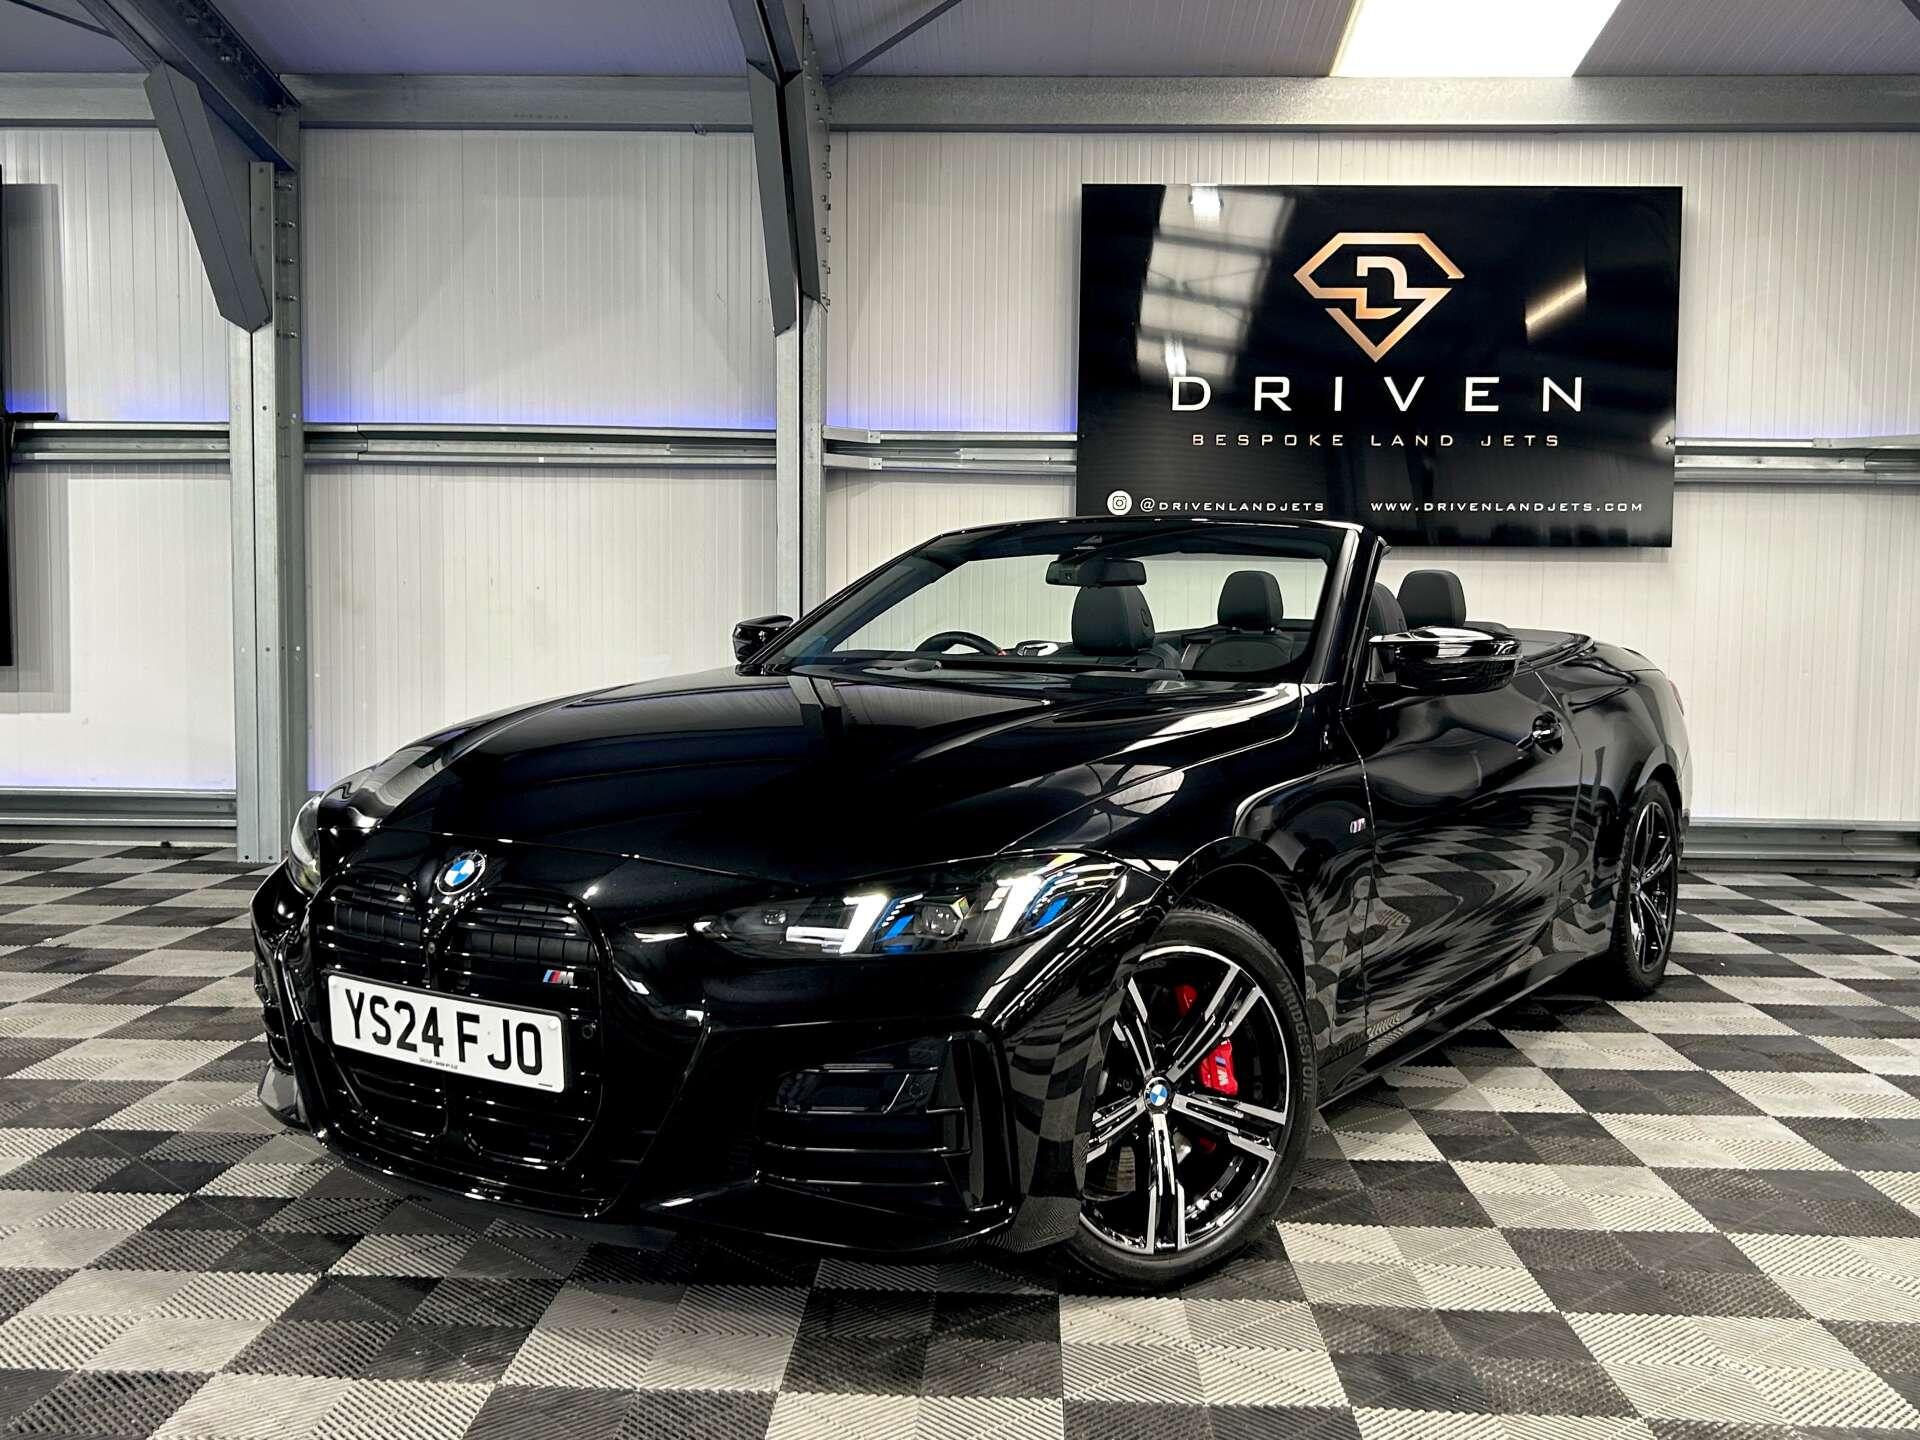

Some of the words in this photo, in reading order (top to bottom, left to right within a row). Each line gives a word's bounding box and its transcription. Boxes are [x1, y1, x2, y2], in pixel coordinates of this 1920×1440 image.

[1170, 376, 1582, 412] DRIVEN
[1192, 434, 1344, 447] BESPOKE
[1370, 434, 1454, 447] LAND
[1480, 434, 1559, 447] JETS
[1139, 497, 1324, 513] @DRIVENLANDJETS
[1370, 502, 1643, 512] WWW.DRIVENLANDJETS.COM
[345, 988, 444, 1058] YS24
[456, 1011, 543, 1076] FJO
[1277, 978, 1315, 1104] BRIDGESTONE
